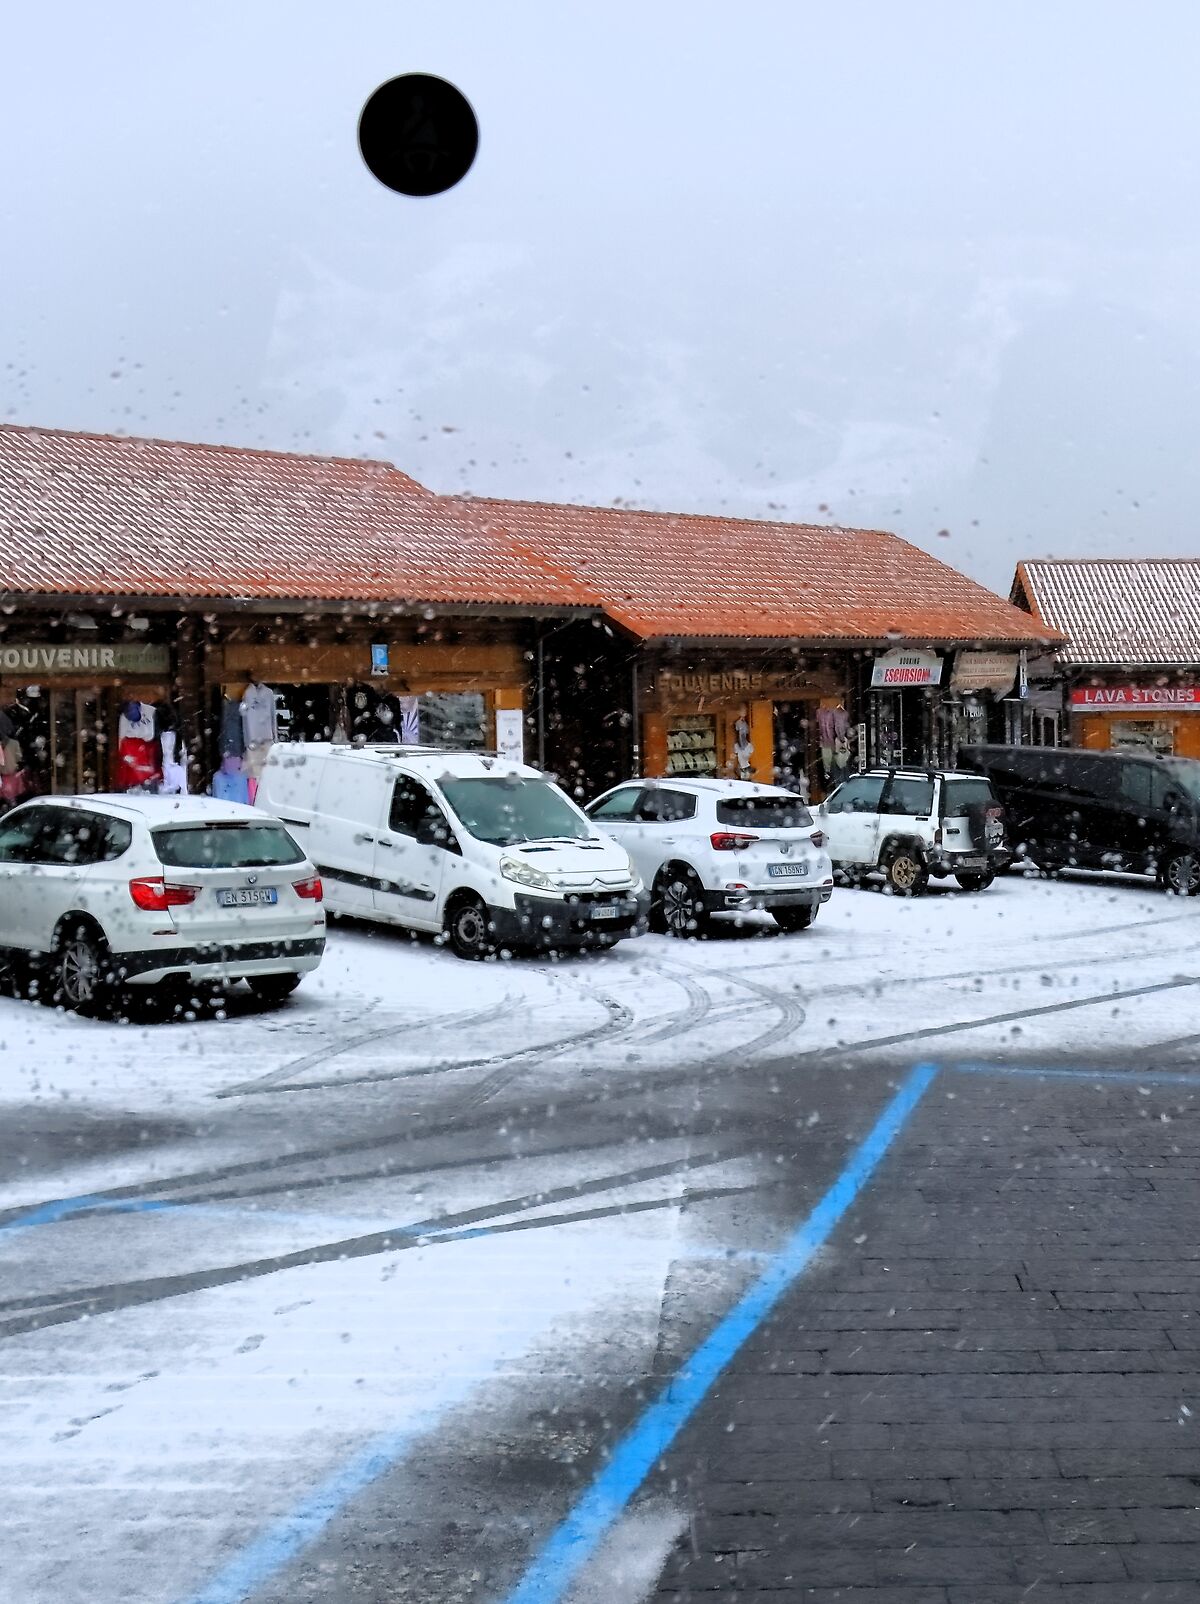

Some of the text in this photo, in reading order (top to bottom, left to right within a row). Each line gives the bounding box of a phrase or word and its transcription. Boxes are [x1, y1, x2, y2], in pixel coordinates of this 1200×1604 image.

[0, 648, 115, 668] OUVENIR
[1021, 686, 1027, 696] P
[1085, 689, 1195, 702] LAVA STONES
